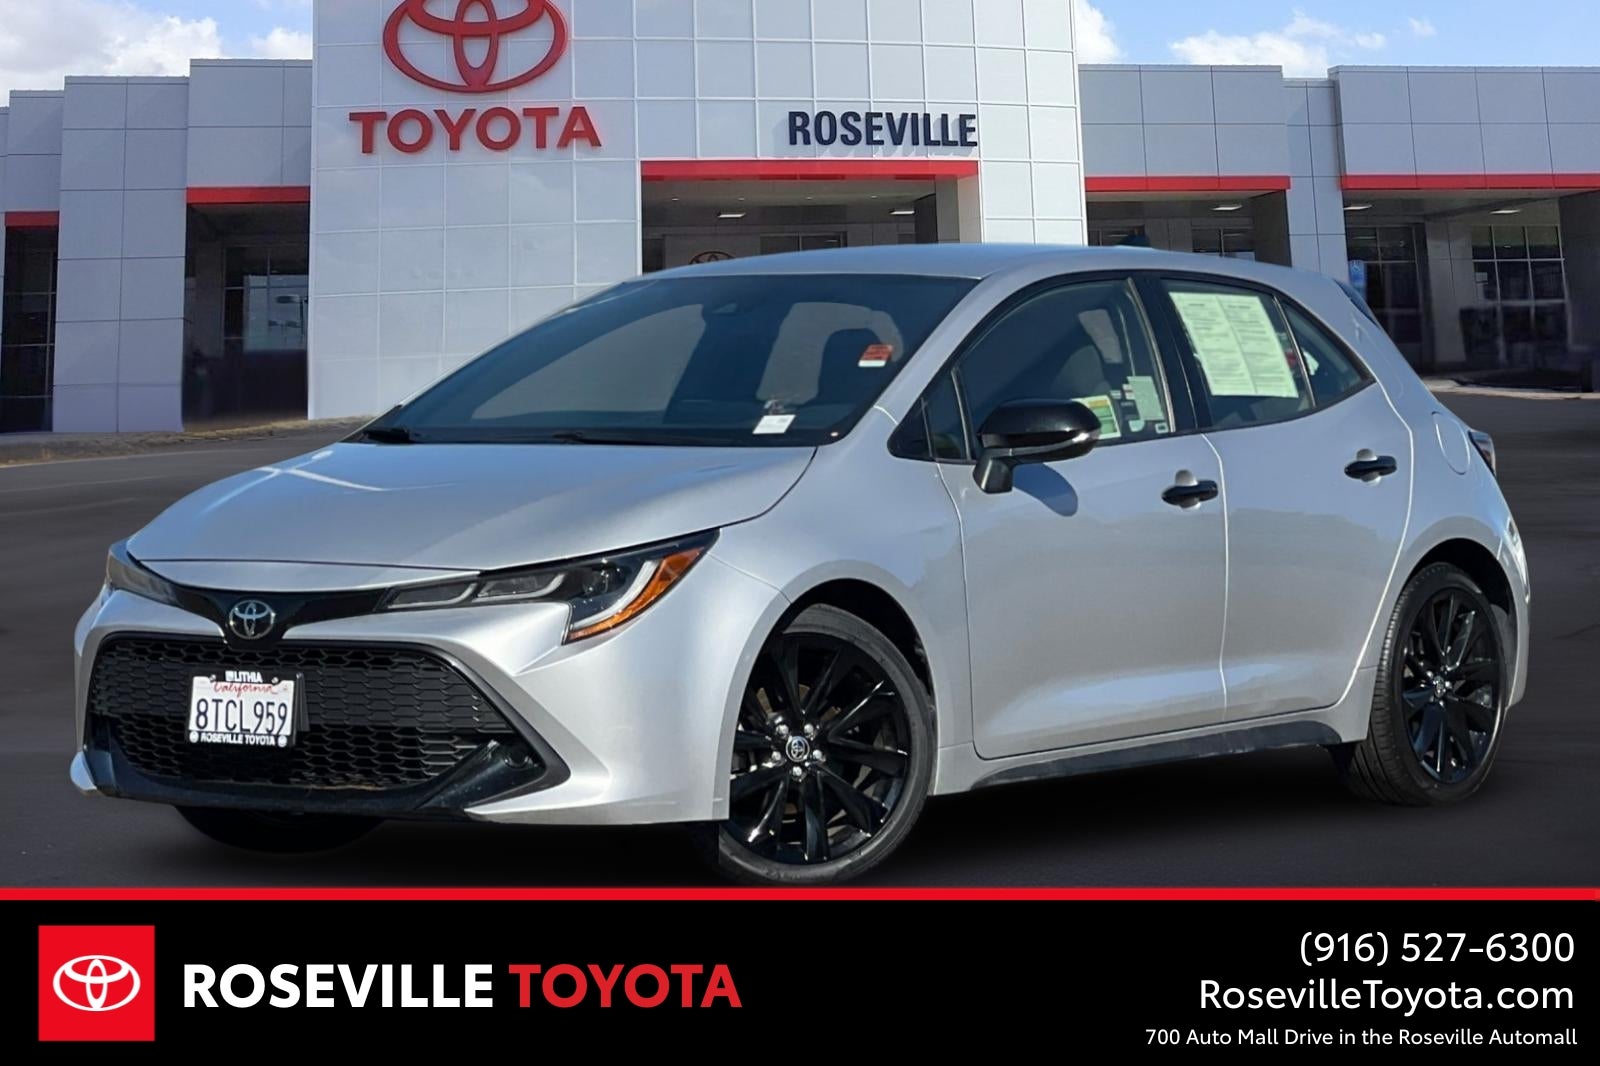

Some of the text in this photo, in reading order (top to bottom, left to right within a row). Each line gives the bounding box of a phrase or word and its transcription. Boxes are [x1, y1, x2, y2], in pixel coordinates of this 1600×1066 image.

[349, 106, 602, 154] TOYOTA
[788, 110, 978, 148] ROSEVILLE
[234, 671, 263, 683] LITHIA
[214, 683, 276, 697] California
[195, 698, 288, 735] 8TCL959
[201, 732, 275, 745] ROSEVILLE TOYOTA
